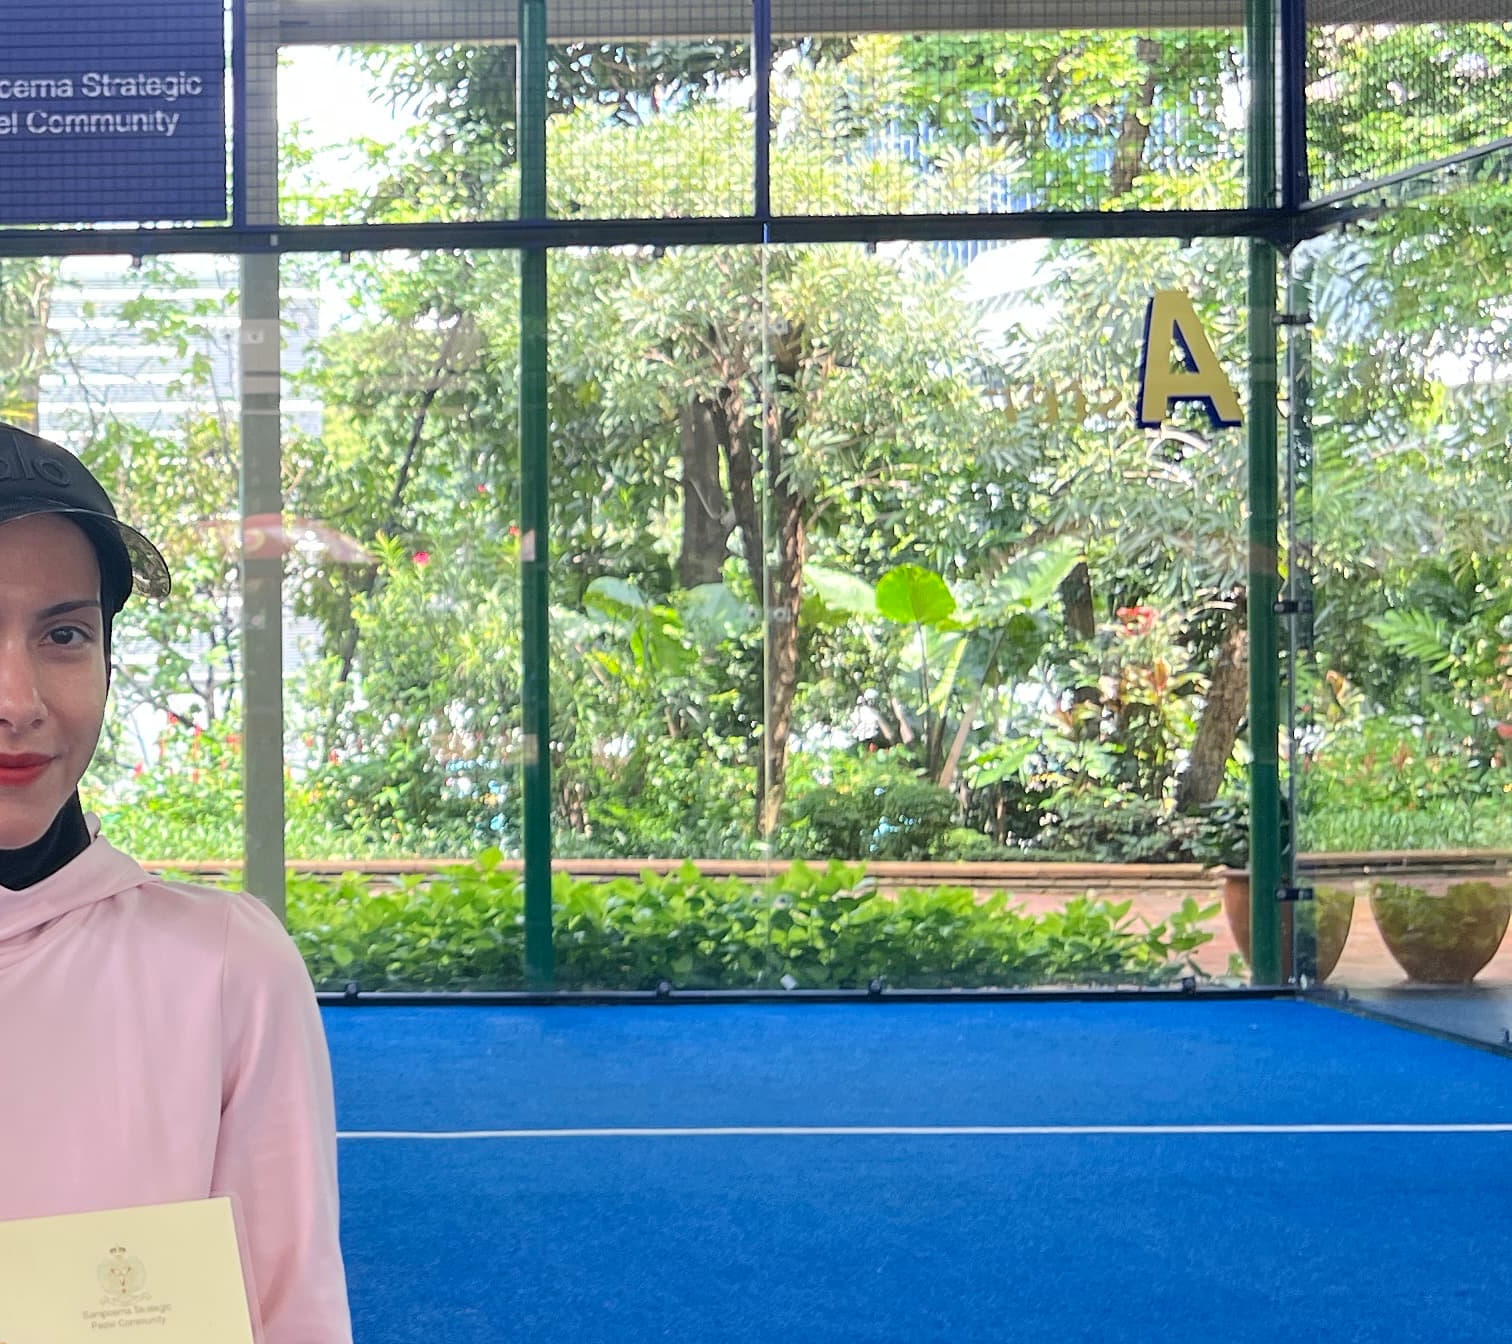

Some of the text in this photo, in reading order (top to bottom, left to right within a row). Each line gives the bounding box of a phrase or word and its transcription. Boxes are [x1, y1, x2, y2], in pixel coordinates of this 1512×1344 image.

[81, 71, 203, 101] Strategic
[26, 109, 180, 136] Community
[1137, 289, 1244, 428] A
